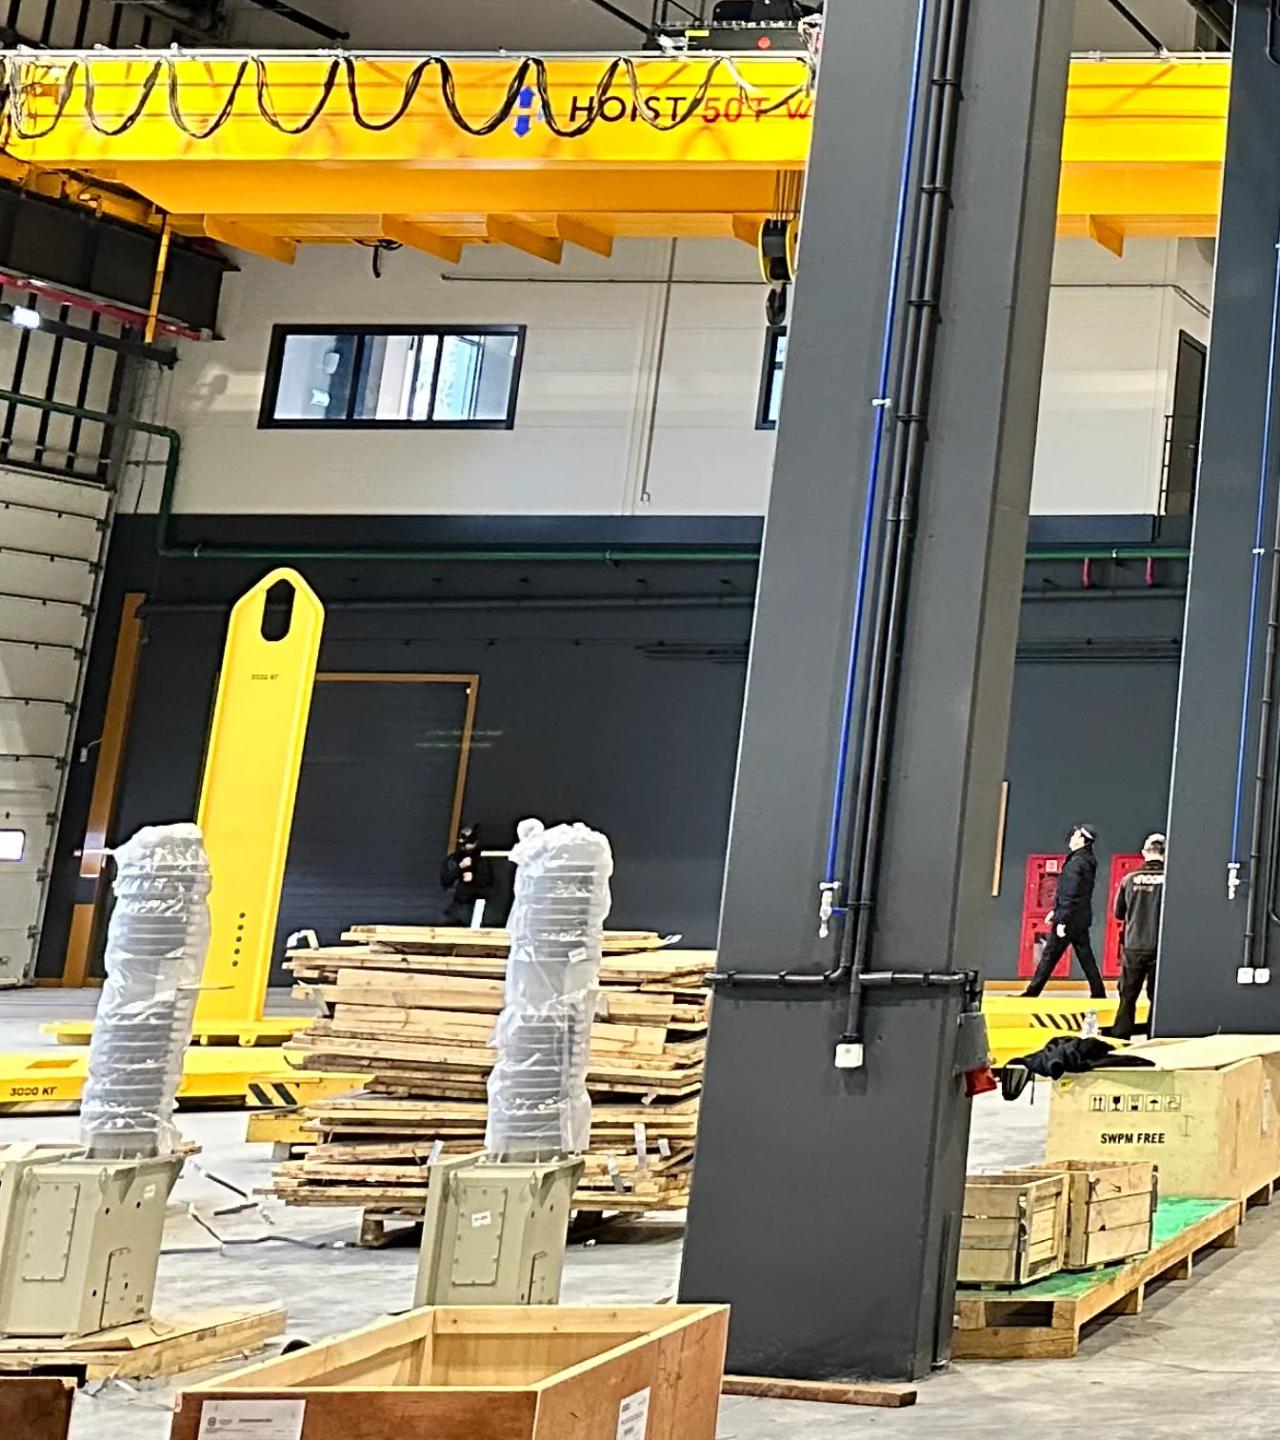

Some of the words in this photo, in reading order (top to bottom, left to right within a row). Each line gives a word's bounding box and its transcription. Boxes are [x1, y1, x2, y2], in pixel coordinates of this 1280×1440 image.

[568, 95, 687, 123] HOIST
[10, 1087, 39, 1096] 3000
[1100, 1132, 1134, 1144] SWPM
[1136, 1132, 1166, 1144] FREE
